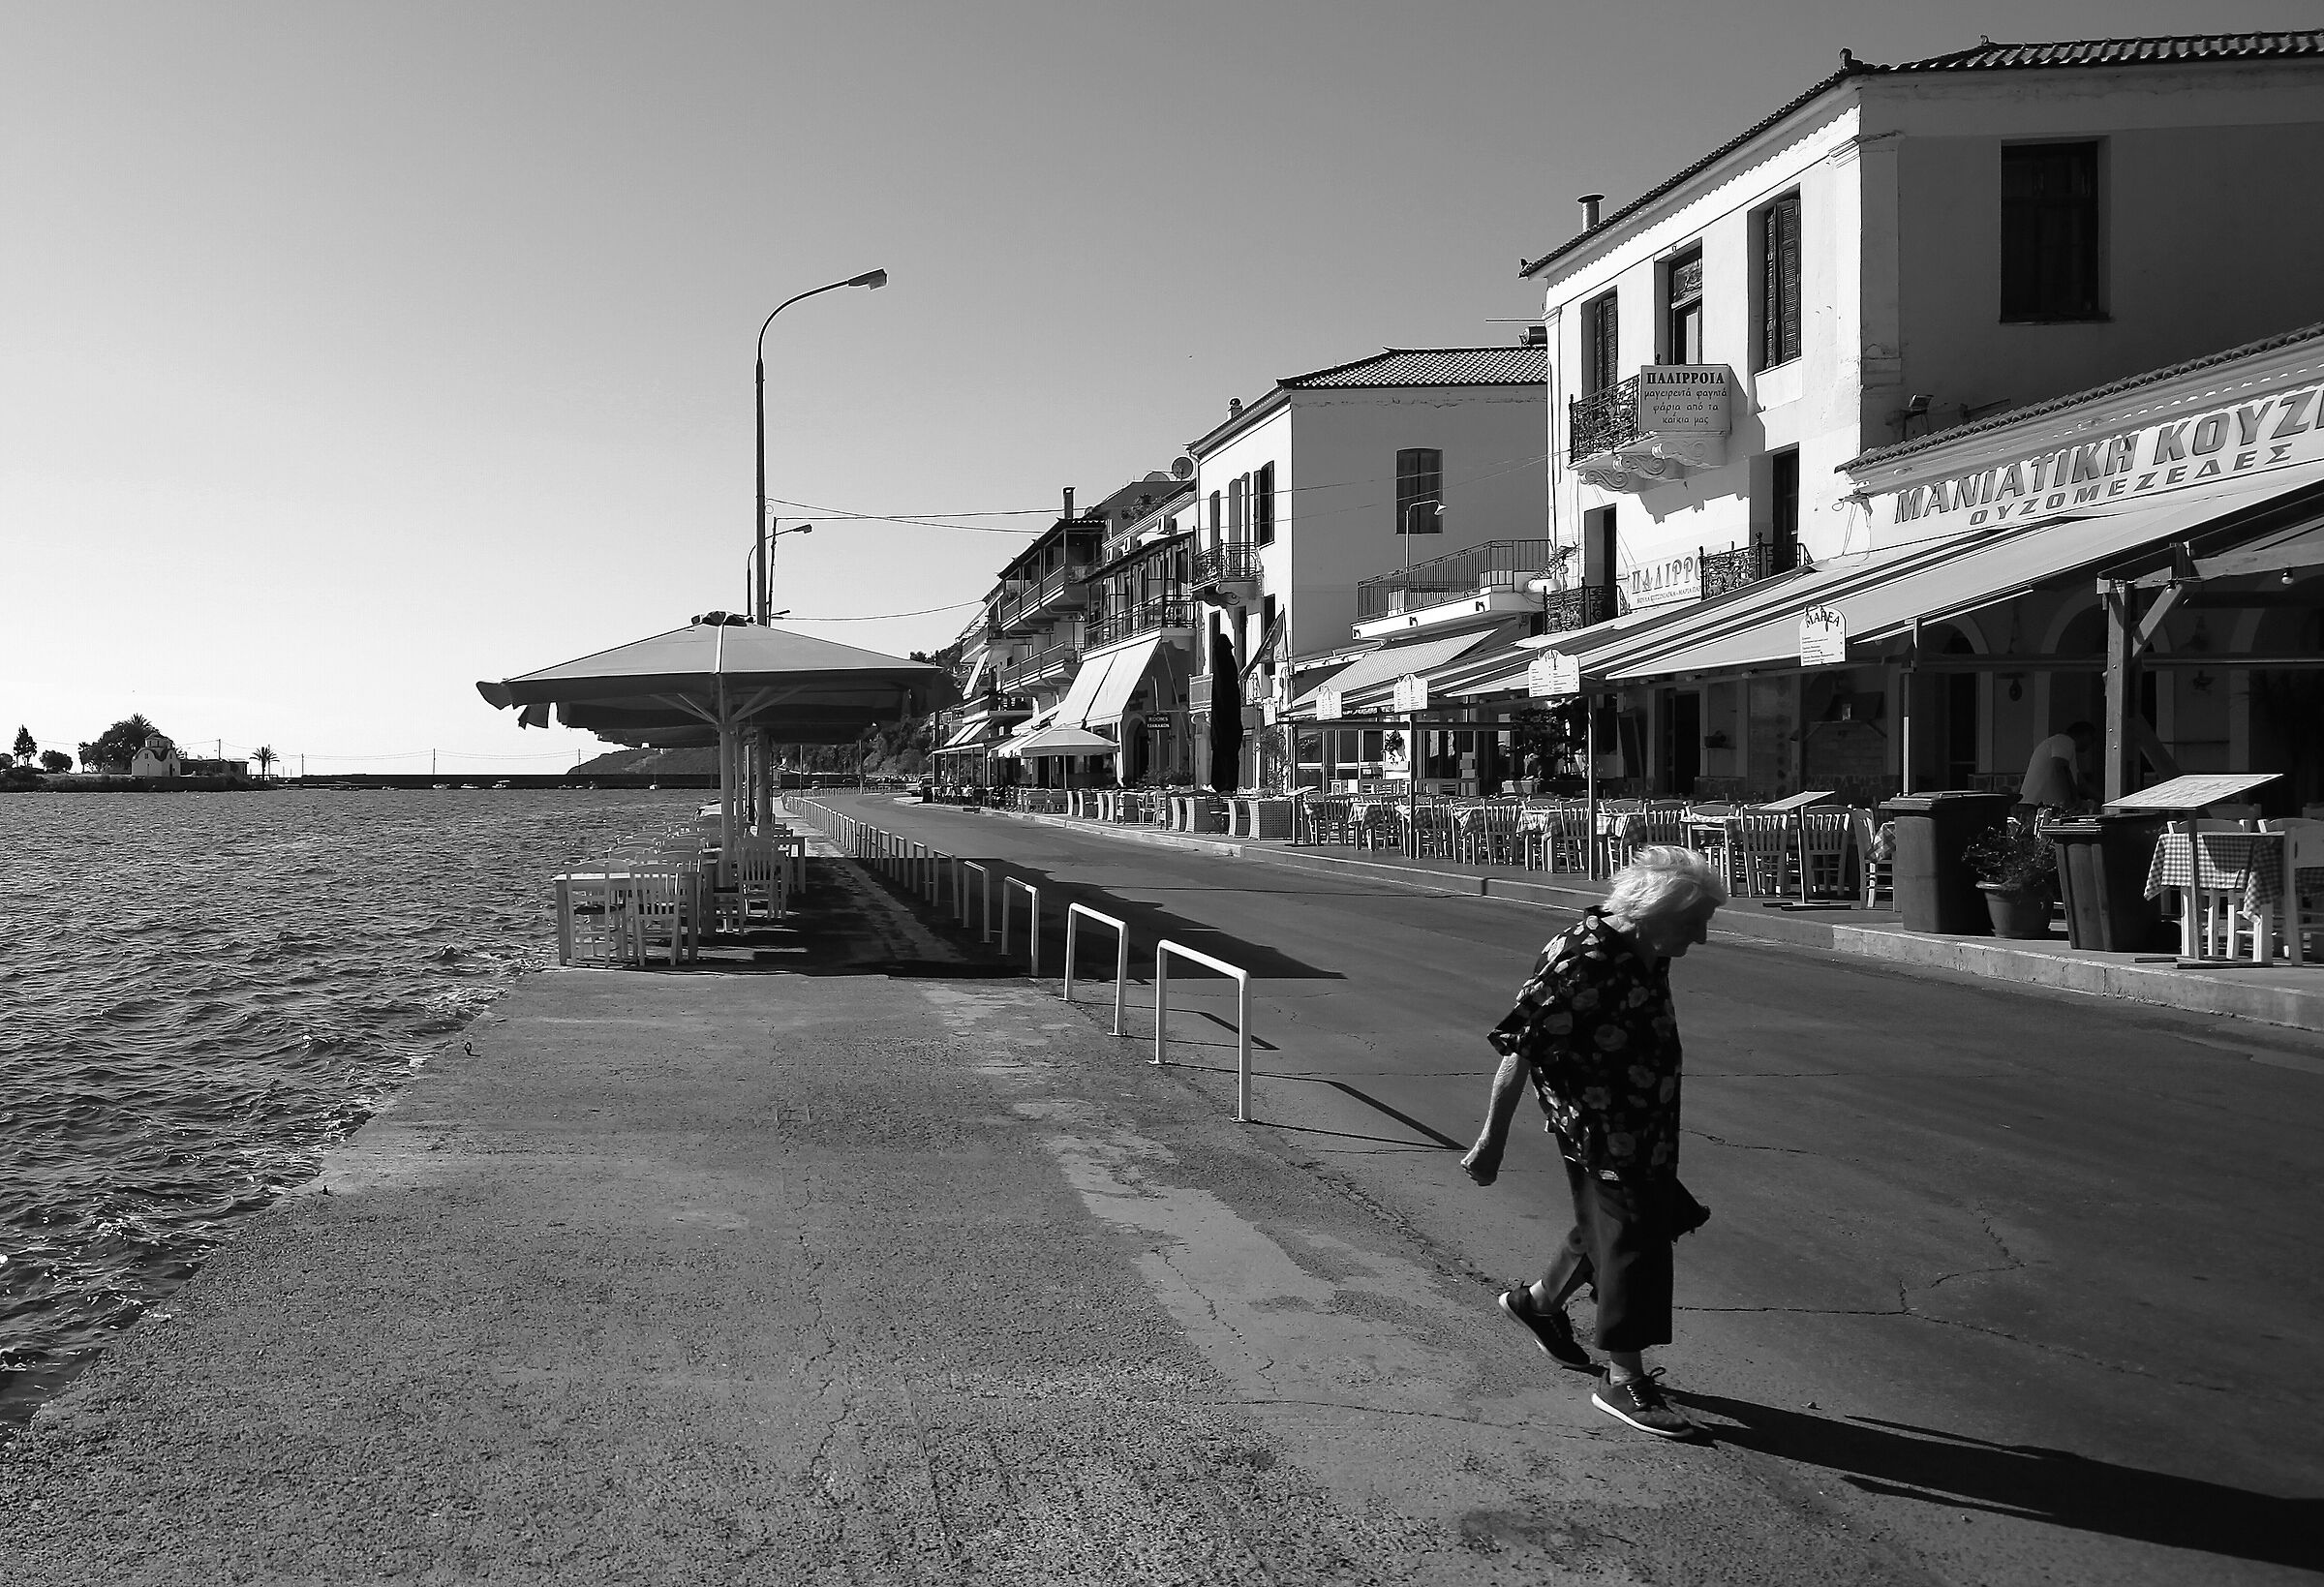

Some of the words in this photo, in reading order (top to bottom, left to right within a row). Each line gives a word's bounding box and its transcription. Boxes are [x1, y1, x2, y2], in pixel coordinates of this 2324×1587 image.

[1646, 372, 1725, 384] ΠΑΛΙΡΡΟΙΑ
[1696, 387, 1727, 400] φαγητά
[1686, 401, 1703, 412] από
[1694, 416, 1709, 427] μας
[1894, 434, 2139, 524] ΜΑΝΙΑΤΙΚΗ
[1970, 443, 2293, 526] ΟΥΖΟΜΕΖΕΔΕΣ
